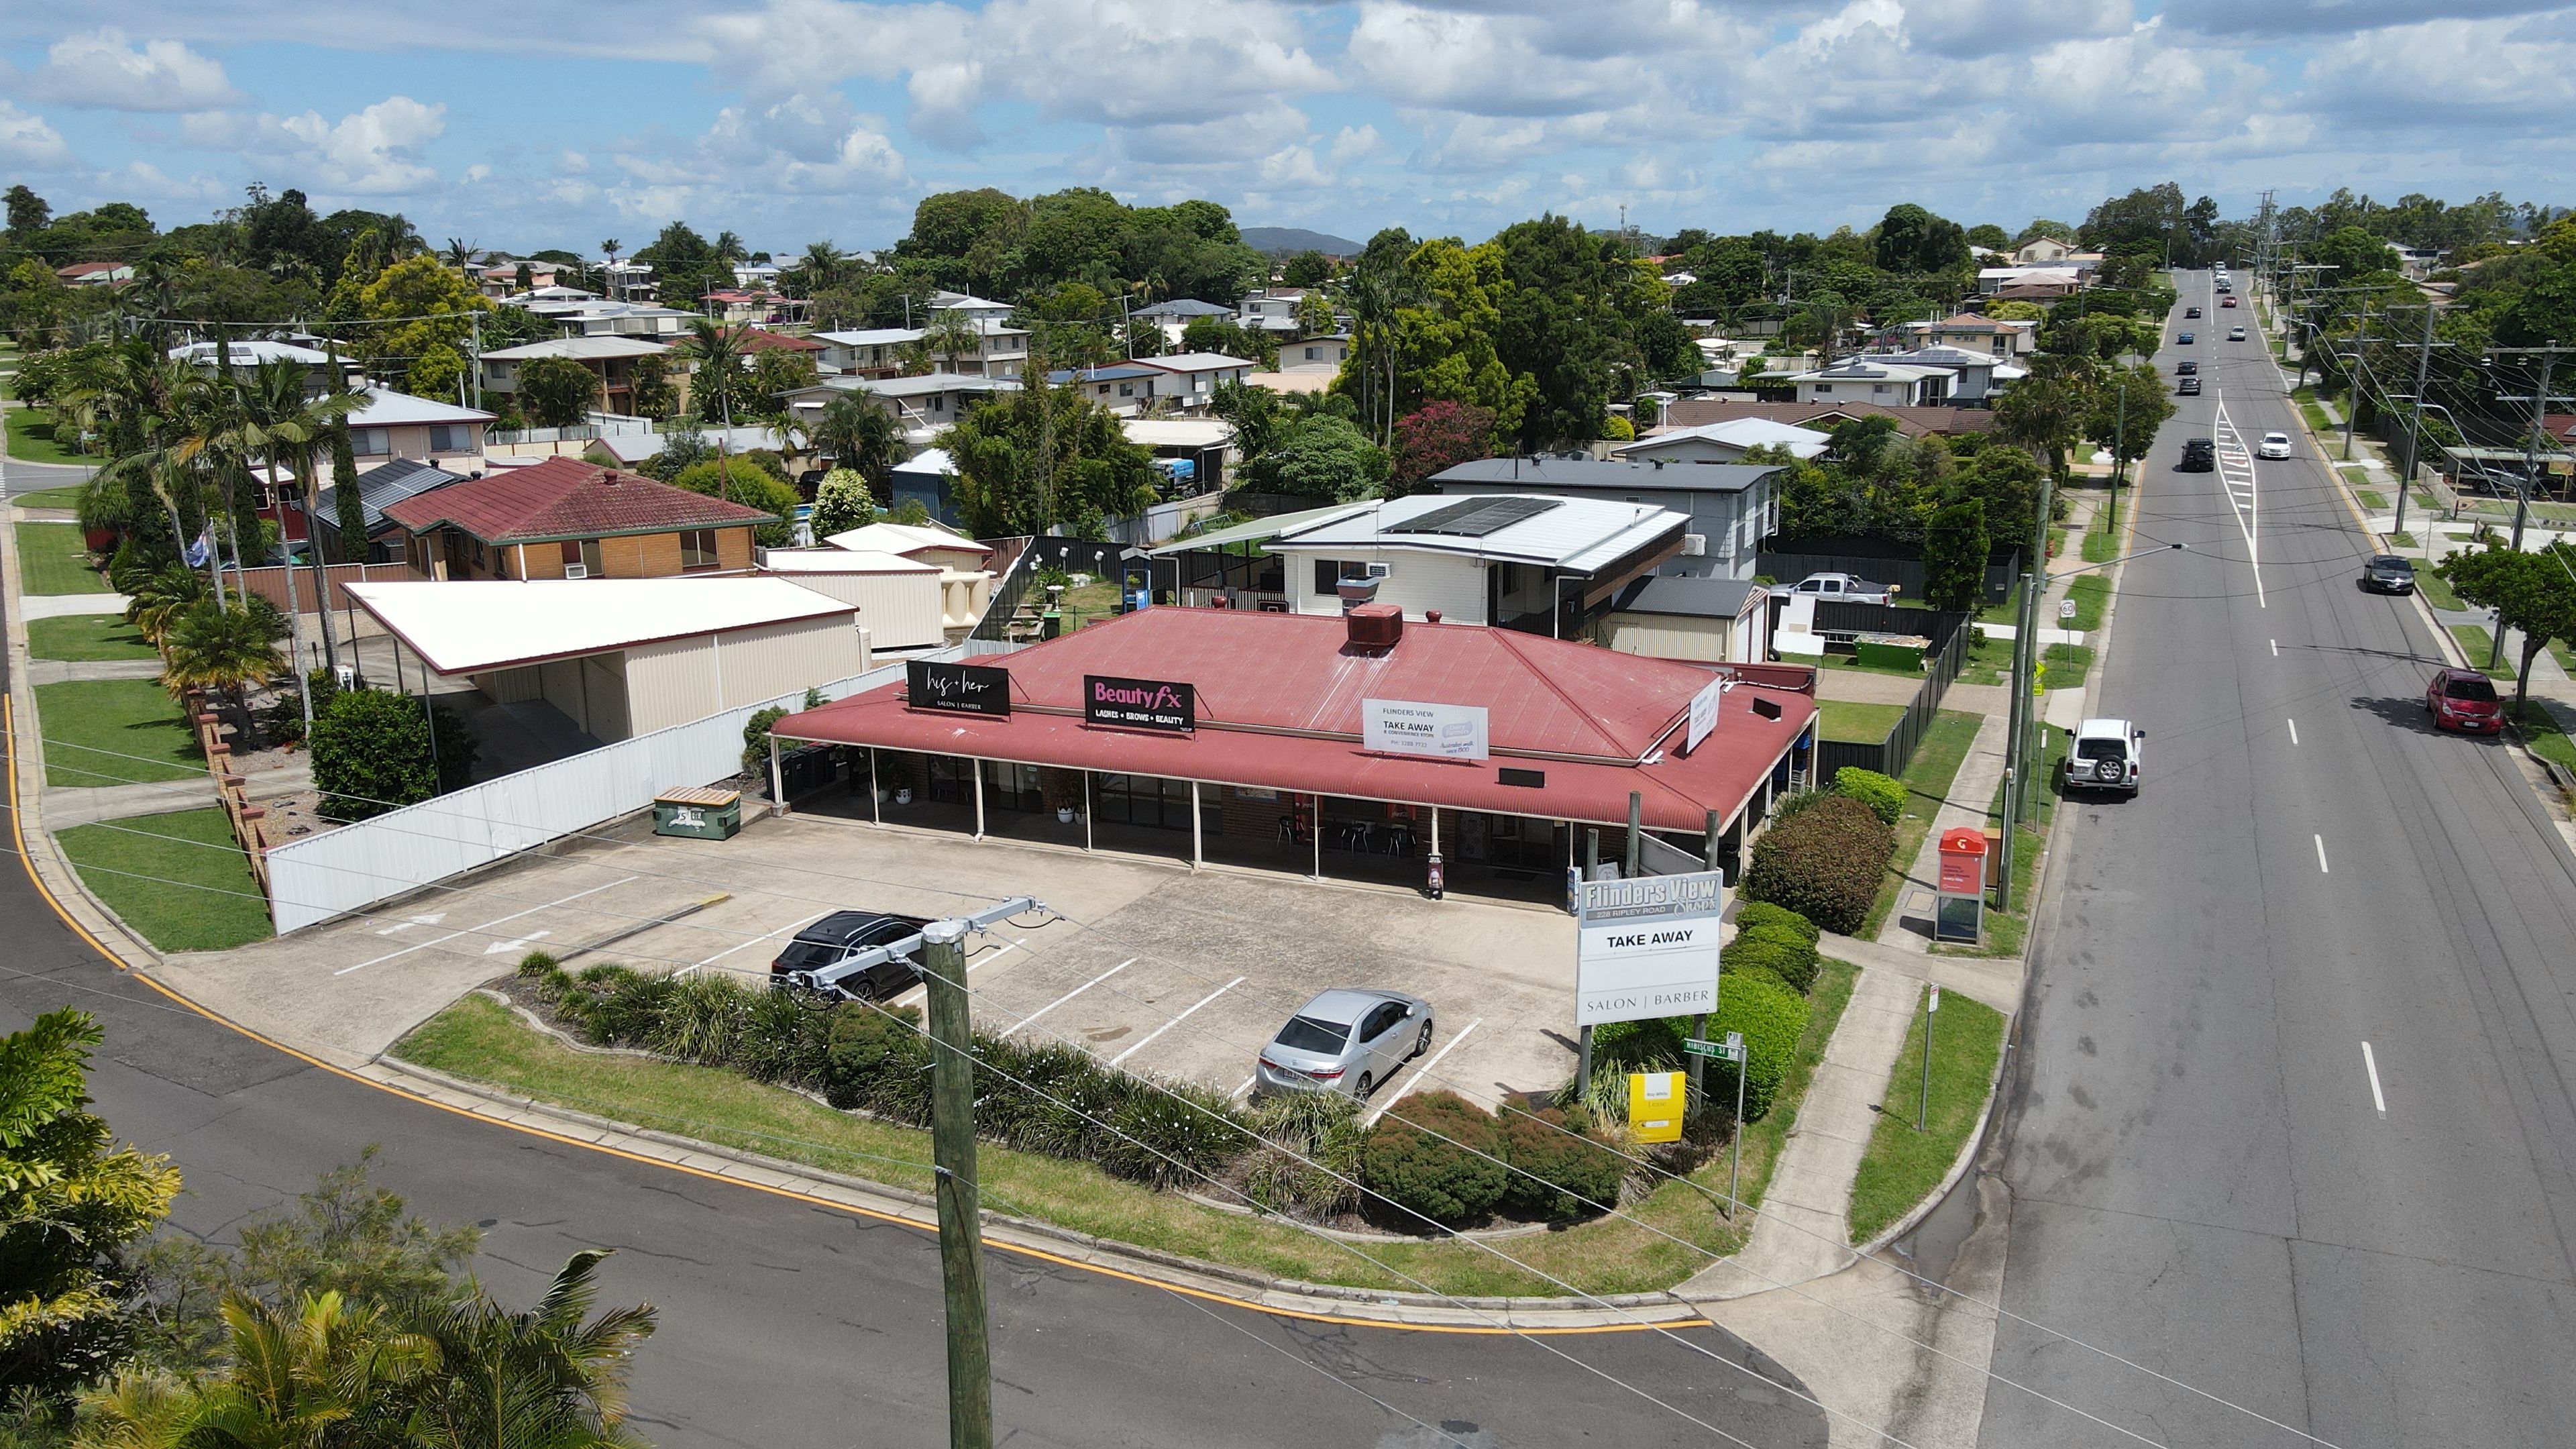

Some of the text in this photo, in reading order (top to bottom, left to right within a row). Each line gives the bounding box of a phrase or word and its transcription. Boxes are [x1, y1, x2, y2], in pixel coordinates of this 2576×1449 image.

[1095, 709, 1184, 725] LASHES BROWS BEAUTY
[1383, 708, 1434, 718] FLINDERS VIEW
[1383, 720, 1434, 733] TAKE AWAY
[1586, 879, 1717, 909] Flinders View
[1612, 909, 1641, 917] RIPLEY
[1643, 906, 1666, 914] ROAD
[1674, 896, 1717, 918] Shops
[1607, 930, 1693, 948] TAKE AWAY
[1587, 990, 1709, 1012] SALON BARBER
[1686, 1041, 1715, 1053] HIBISCUS
[1718, 1046, 1725, 1055] ST
